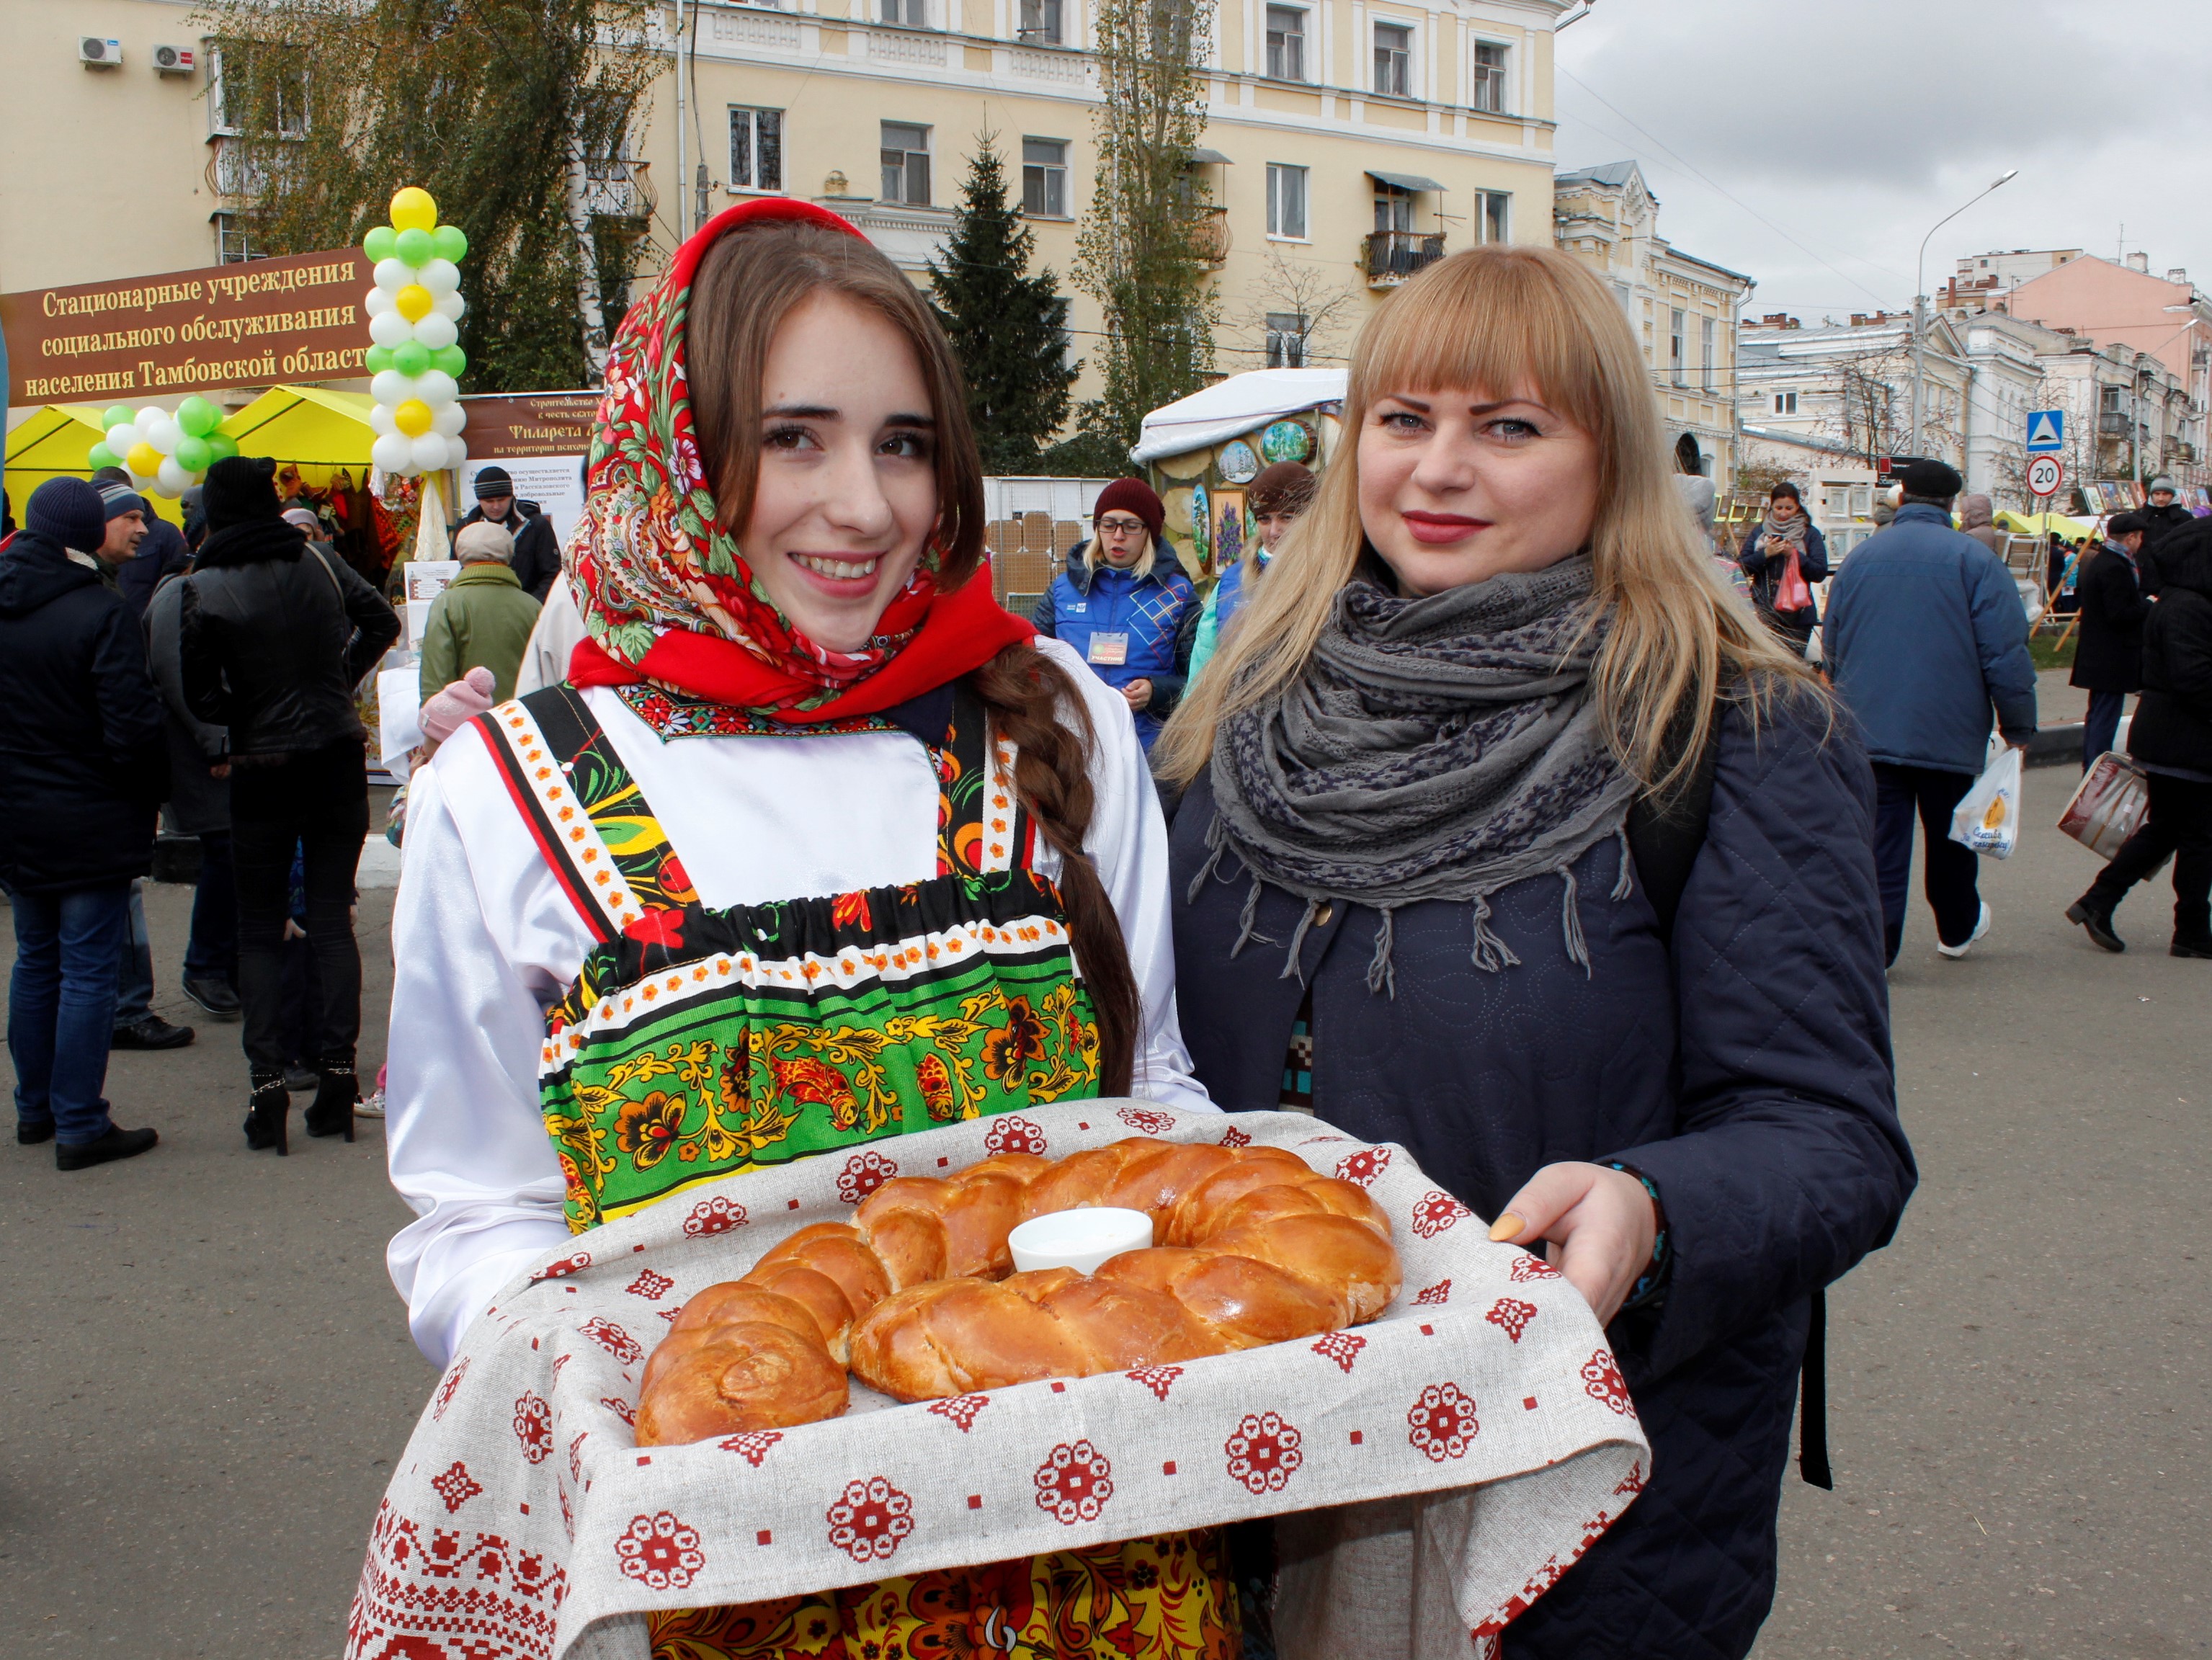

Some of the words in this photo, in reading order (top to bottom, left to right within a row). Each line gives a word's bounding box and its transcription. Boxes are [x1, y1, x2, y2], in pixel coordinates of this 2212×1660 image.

[43, 280, 202, 317] Стационарные
[207, 262, 356, 304] учреждения
[42, 326, 175, 358] социального
[181, 305, 356, 343] обслуживания
[25, 371, 135, 396] населения
[139, 349, 277, 387] Тамбовской
[282, 346, 368, 374] област
[545, 411, 570, 419] честь
[509, 425, 582, 442] Филарета
[507, 444, 555, 455] территории
[2035, 468, 2054, 483] 20
